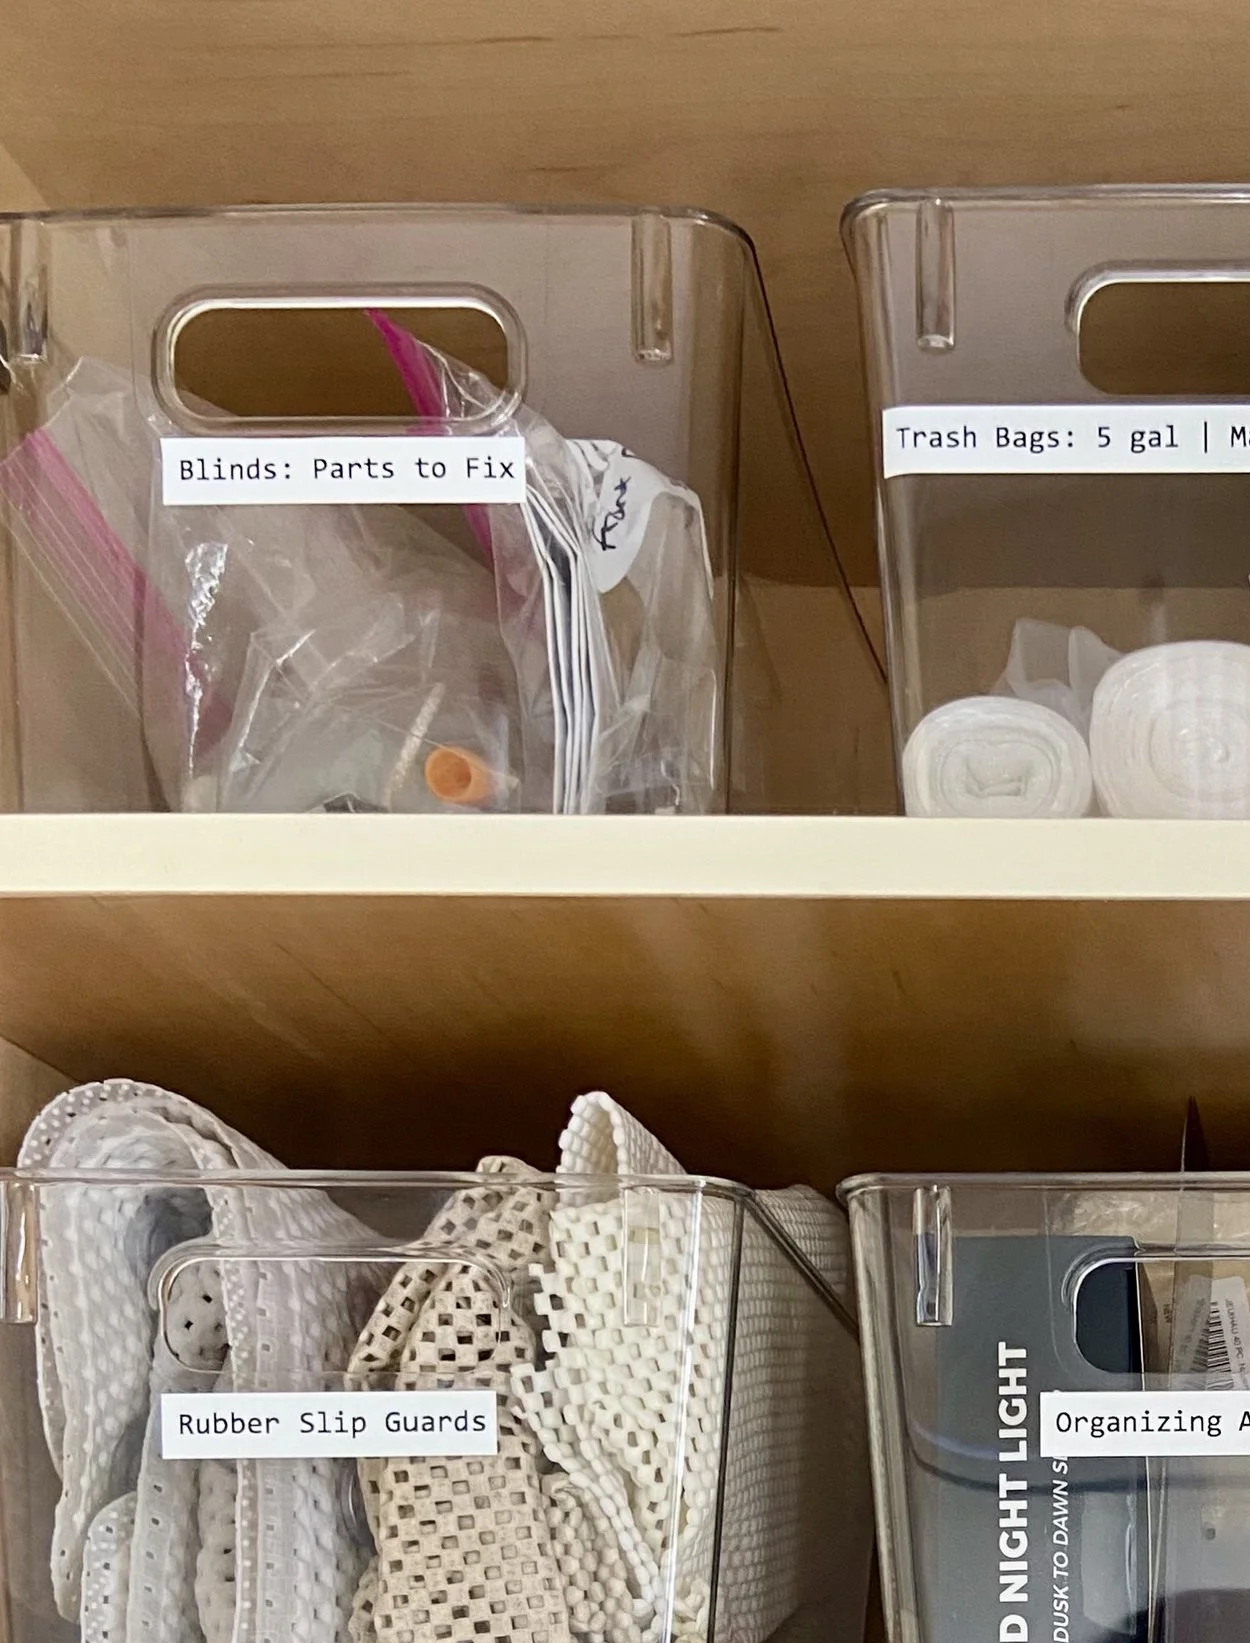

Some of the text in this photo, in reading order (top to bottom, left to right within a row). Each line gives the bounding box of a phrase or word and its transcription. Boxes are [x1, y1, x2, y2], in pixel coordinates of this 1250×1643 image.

[898, 424, 976, 449] Trash
[996, 424, 1075, 454] Bags:
[1098, 425, 1111, 449] 5
[1130, 424, 1179, 454] gal
[180, 455, 515, 482] Blinds: Parts to Fix
[997, 1341, 1029, 1462] LIGHT
[178, 1409, 487, 1440] Rubber Slip Guards
[1055, 1408, 1223, 1439] Organizing
[1052, 1480, 1069, 1546] DAWN
[998, 1473, 1030, 1603] NIGHT
[1052, 1551, 1069, 1580] TO
[1052, 1584, 1070, 1643] DUSK
